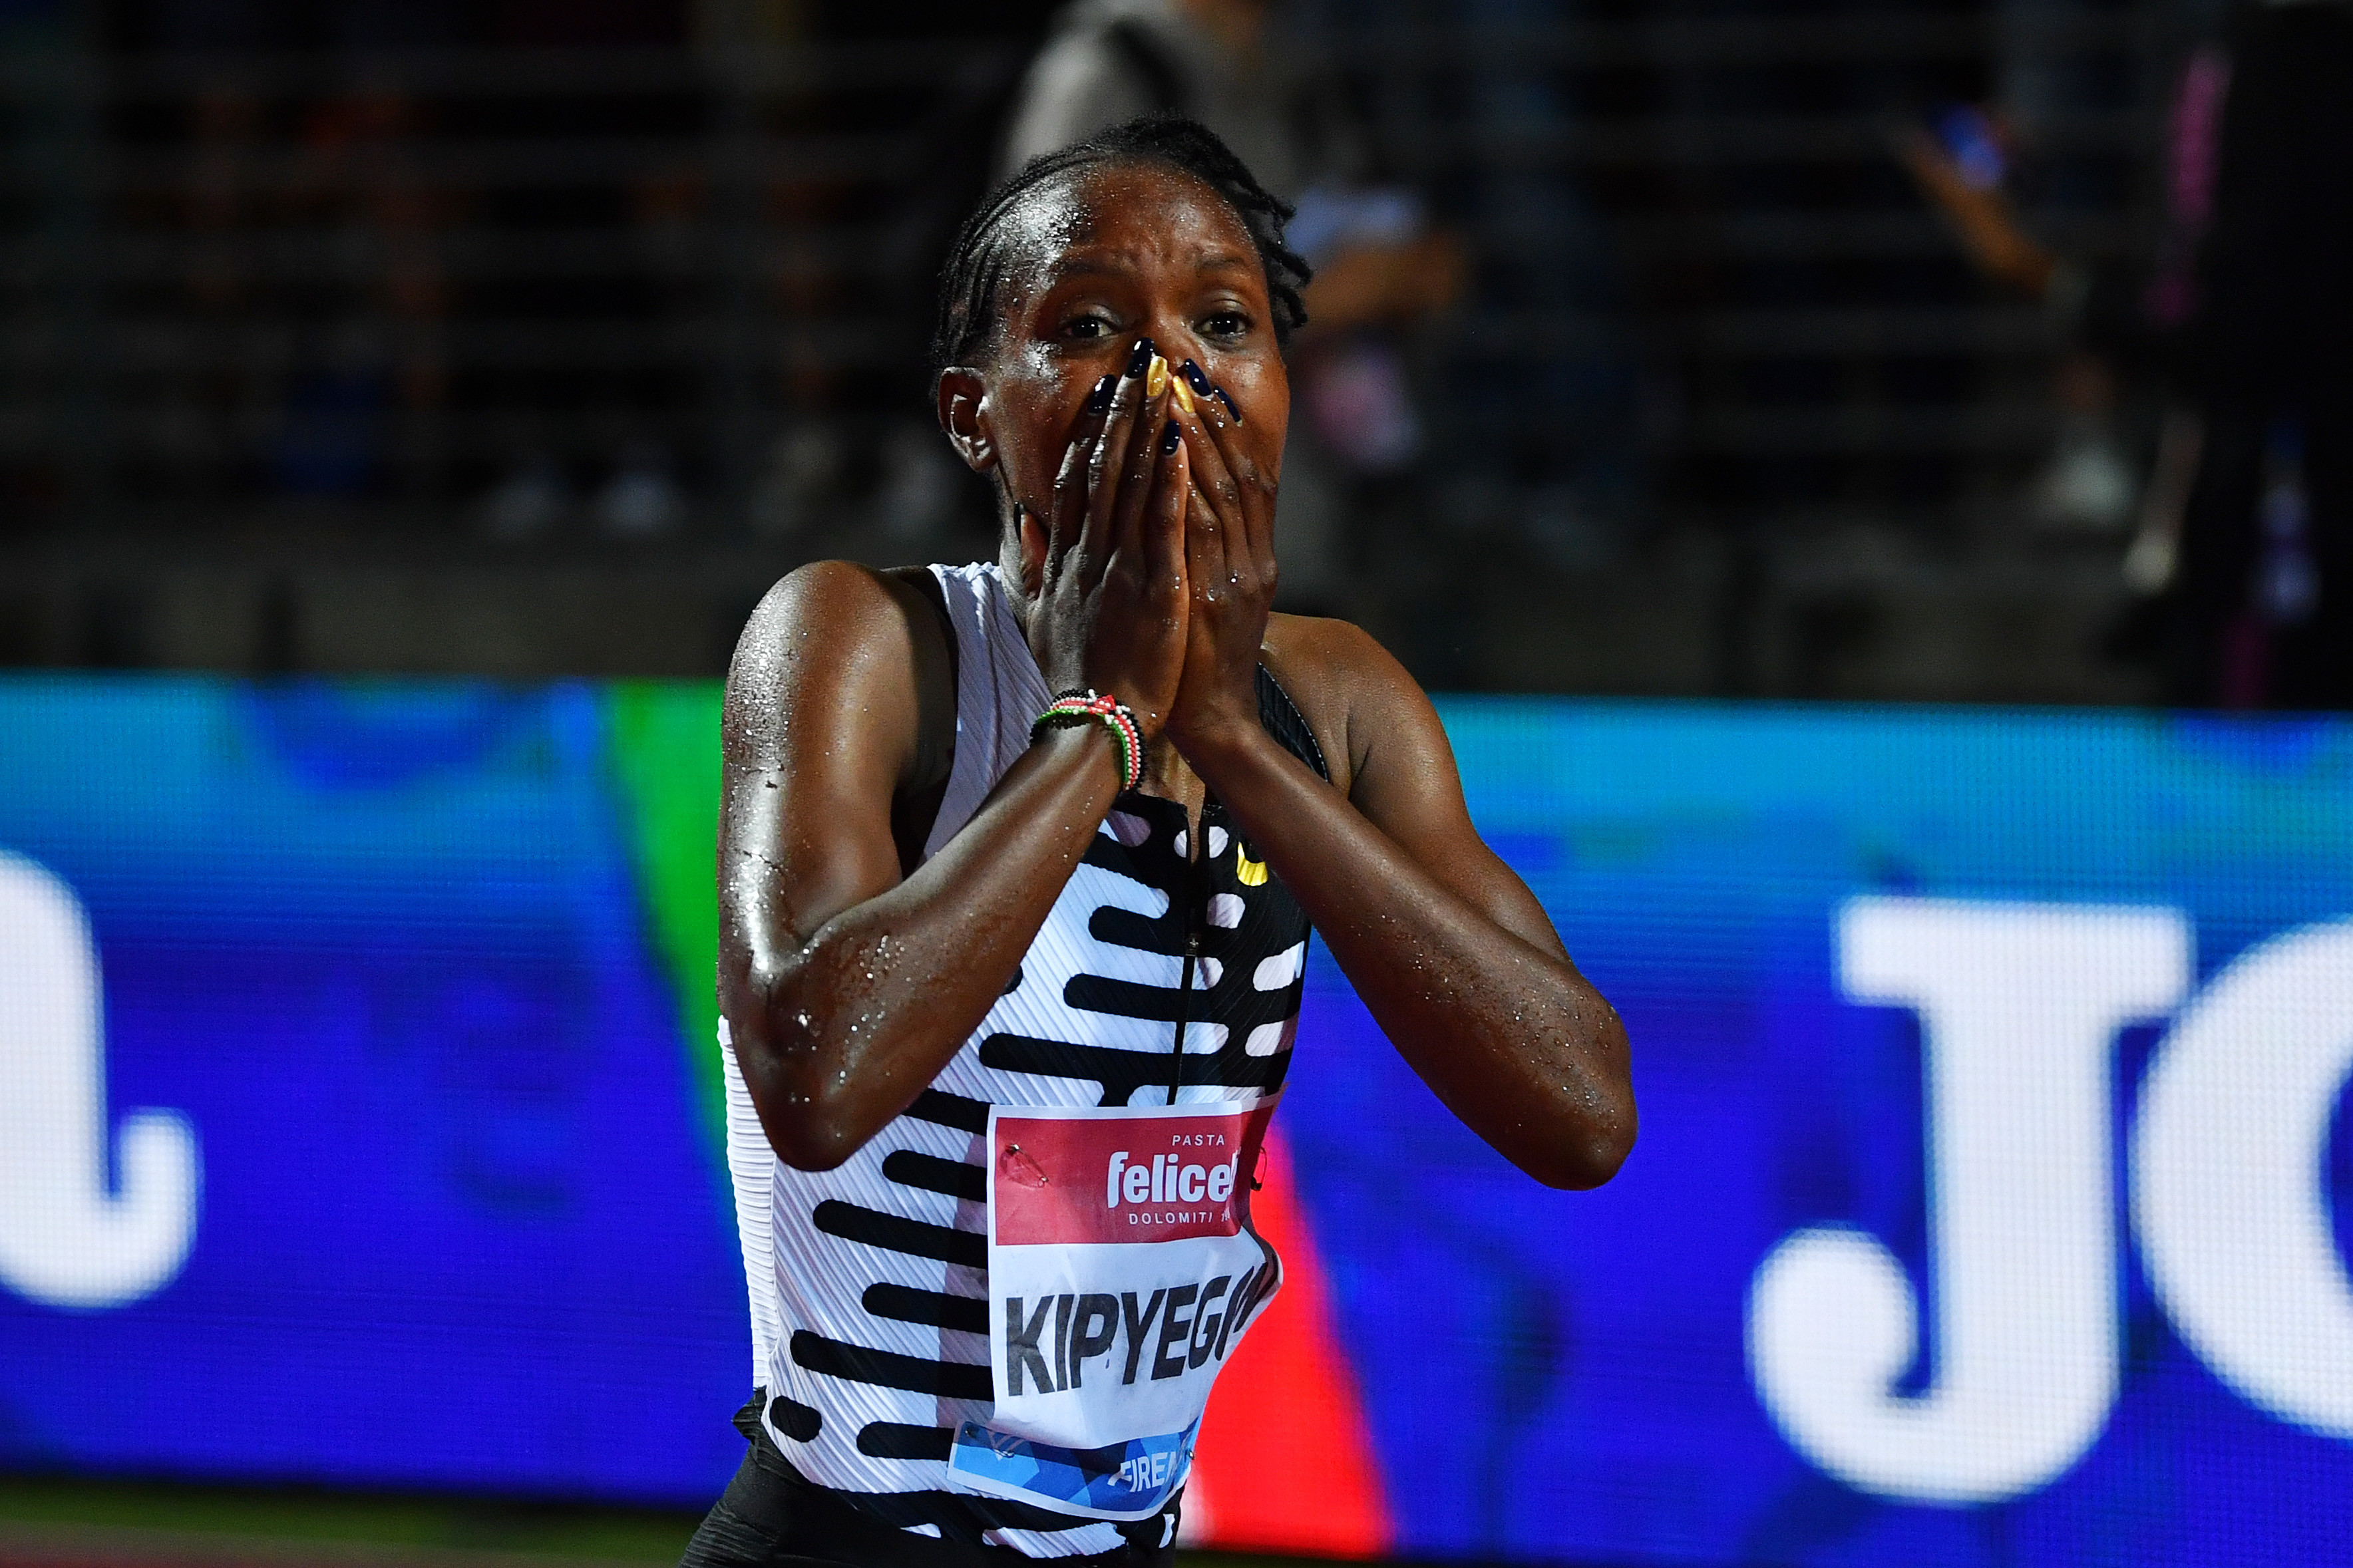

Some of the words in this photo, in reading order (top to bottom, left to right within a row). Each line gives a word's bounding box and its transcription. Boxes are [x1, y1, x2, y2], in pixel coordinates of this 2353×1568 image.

[1172, 1134, 1225, 1146] PASTA
[1107, 1148, 1240, 1208] felice
[1129, 1211, 1213, 1225] DOLOMITI
